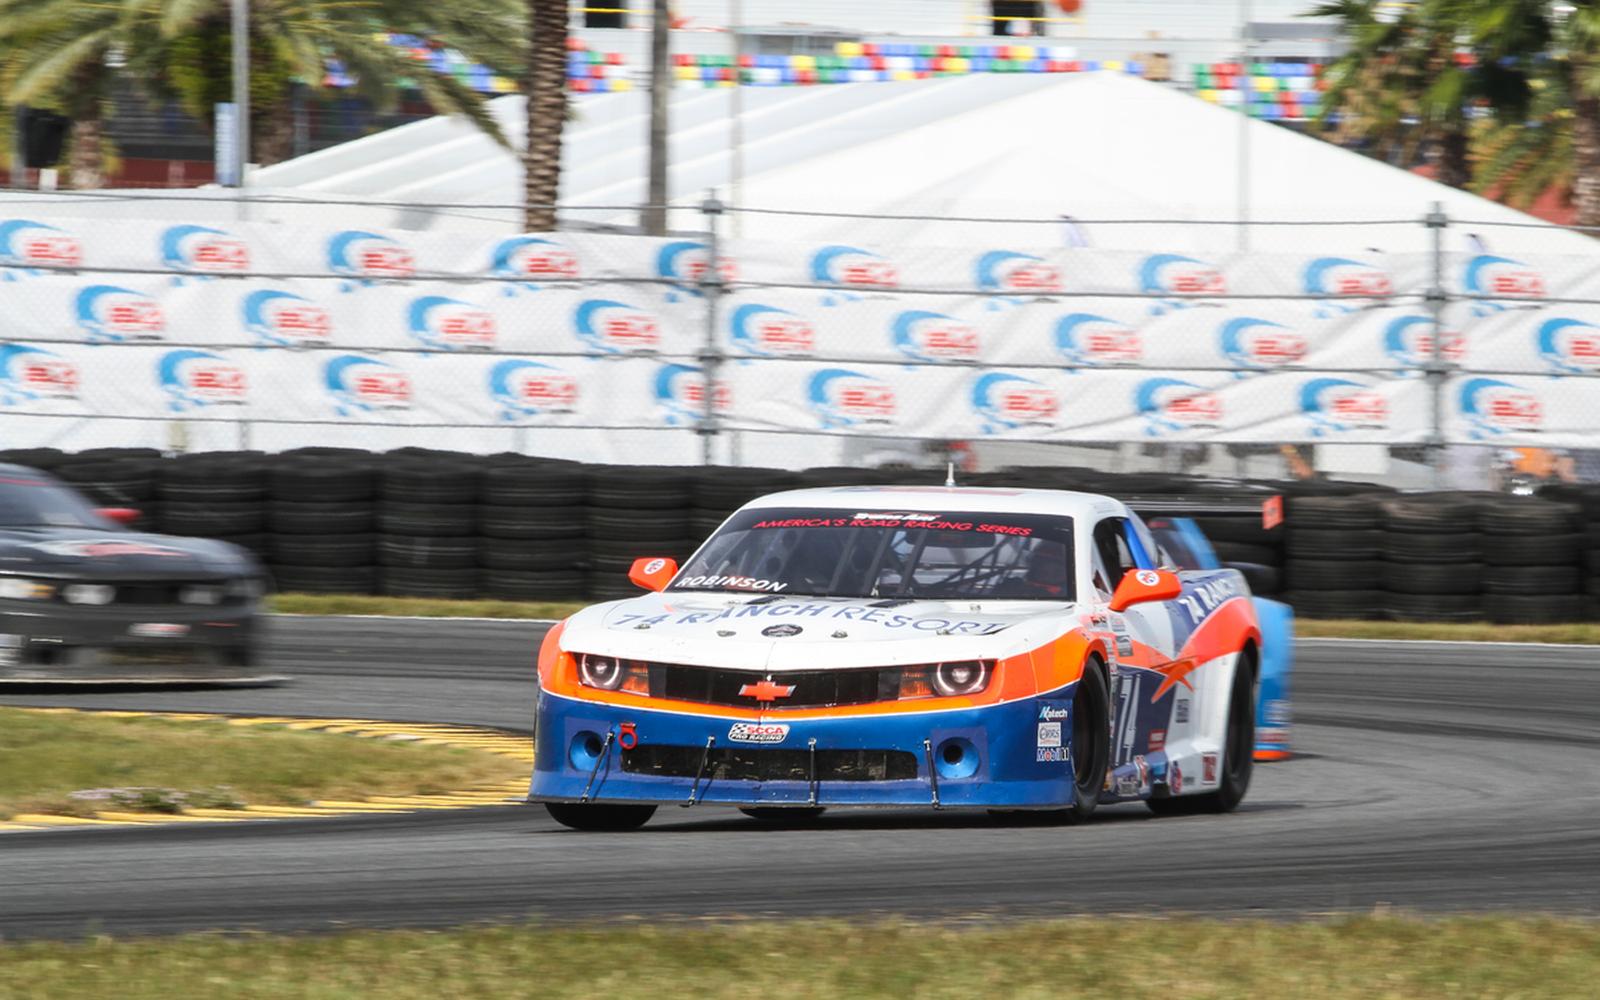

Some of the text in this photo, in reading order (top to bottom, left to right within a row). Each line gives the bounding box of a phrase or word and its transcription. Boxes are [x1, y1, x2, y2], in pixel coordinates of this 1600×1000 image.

[752, 518, 1033, 536] AMERICA'S ROAD RACING SERIES
[675, 575, 788, 592] ROBINSON
[614, 604, 1007, 633] 74 RANCH RESORT
[731, 732, 749, 740] PRO
[747, 726, 784, 734] SCCA
[1036, 747, 1061, 762] Mobil
